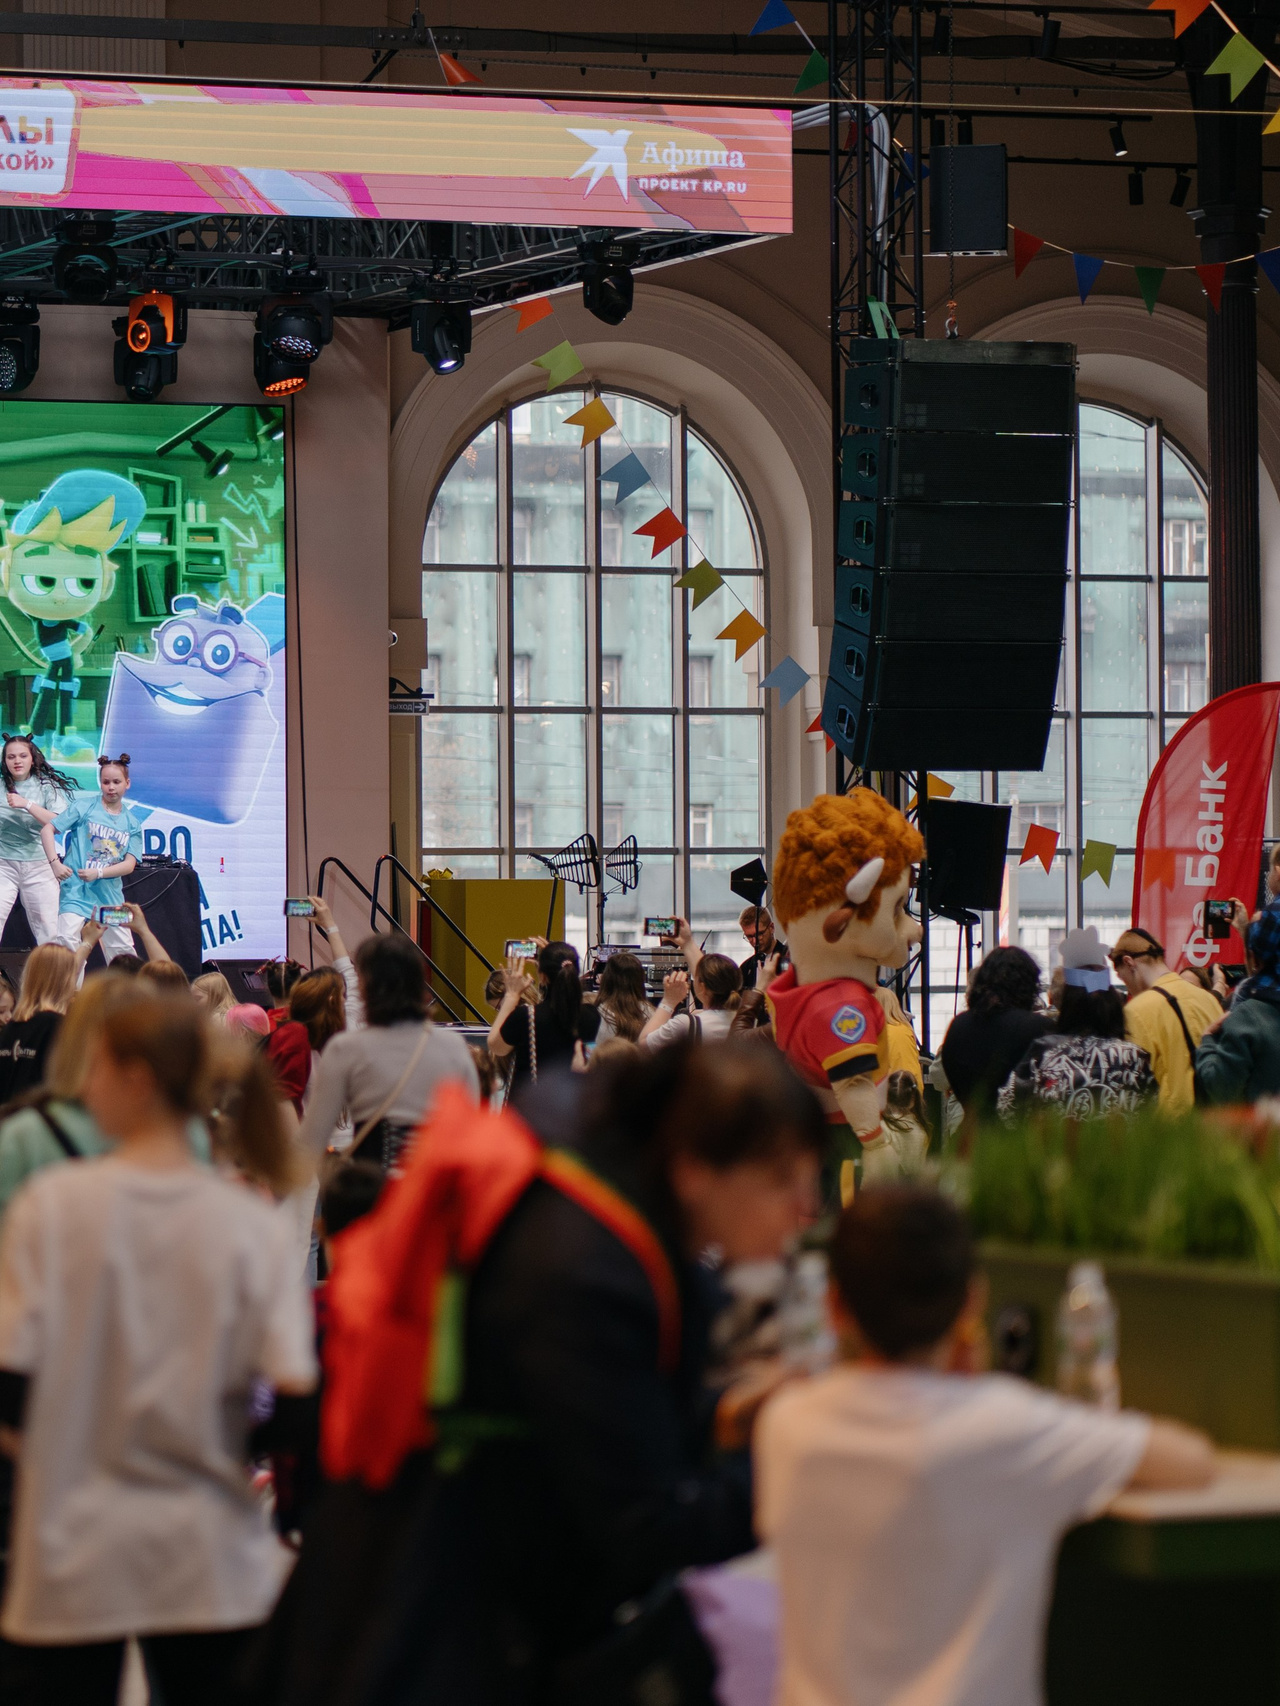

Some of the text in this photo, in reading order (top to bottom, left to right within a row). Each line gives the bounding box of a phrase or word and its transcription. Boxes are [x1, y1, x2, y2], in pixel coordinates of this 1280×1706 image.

[639, 141, 746, 173] Афиша
[638, 177, 747, 194] ПРОЕКТ KP.RU
[1184, 760, 1228, 887] Банк
[201, 909, 244, 951] ПА!
